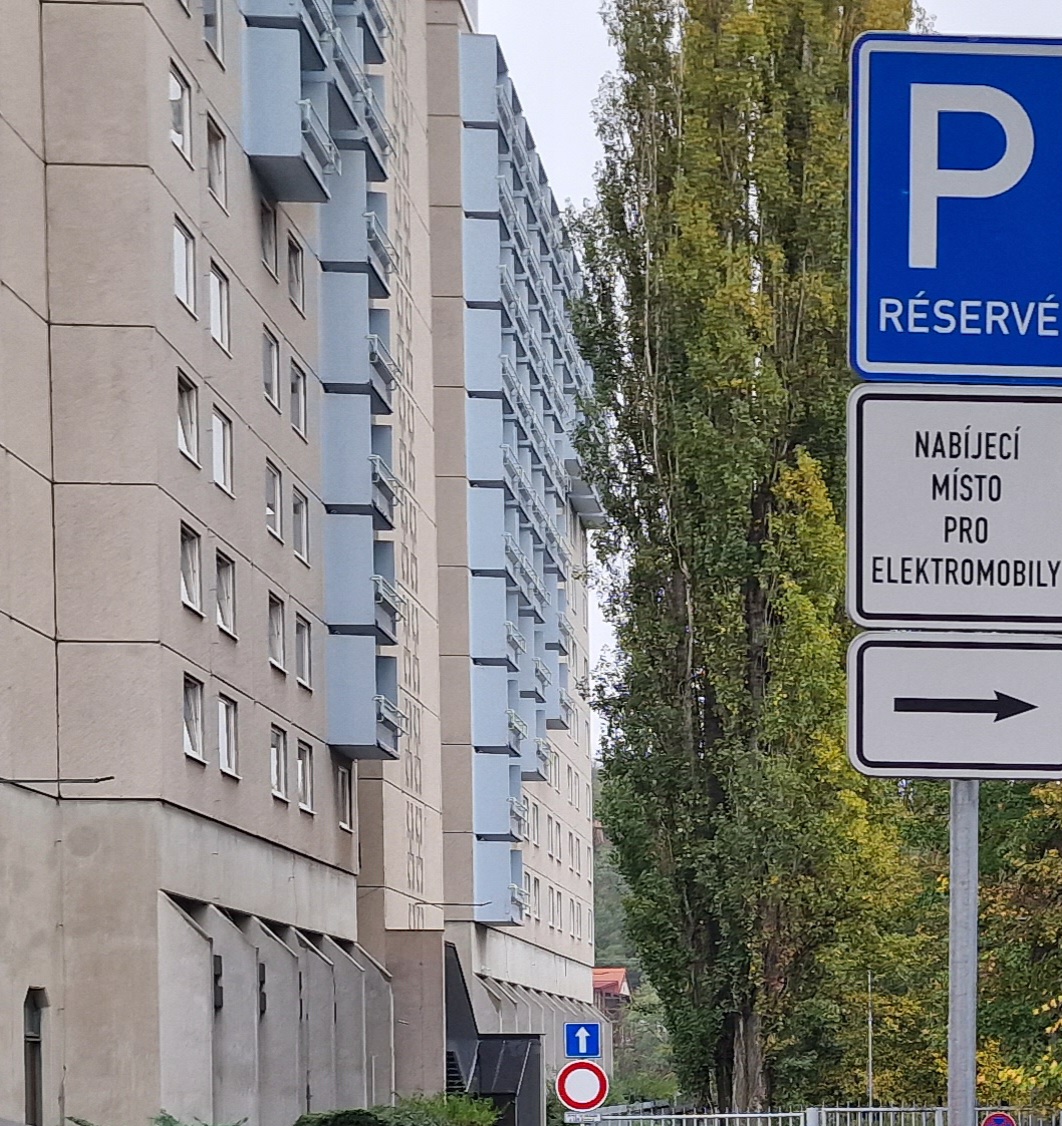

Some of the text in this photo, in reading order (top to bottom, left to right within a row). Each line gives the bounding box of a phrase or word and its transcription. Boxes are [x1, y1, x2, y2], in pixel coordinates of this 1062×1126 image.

[908, 82, 1035, 269] P
[879, 290, 1060, 337] RÉSERVÉ
[914, 424, 1021, 460] NABÍJECÍ
[931, 467, 1002, 502] MÍSTO
[944, 516, 988, 544] PRO
[871, 556, 1061, 588] ELEKTROMOBILY
